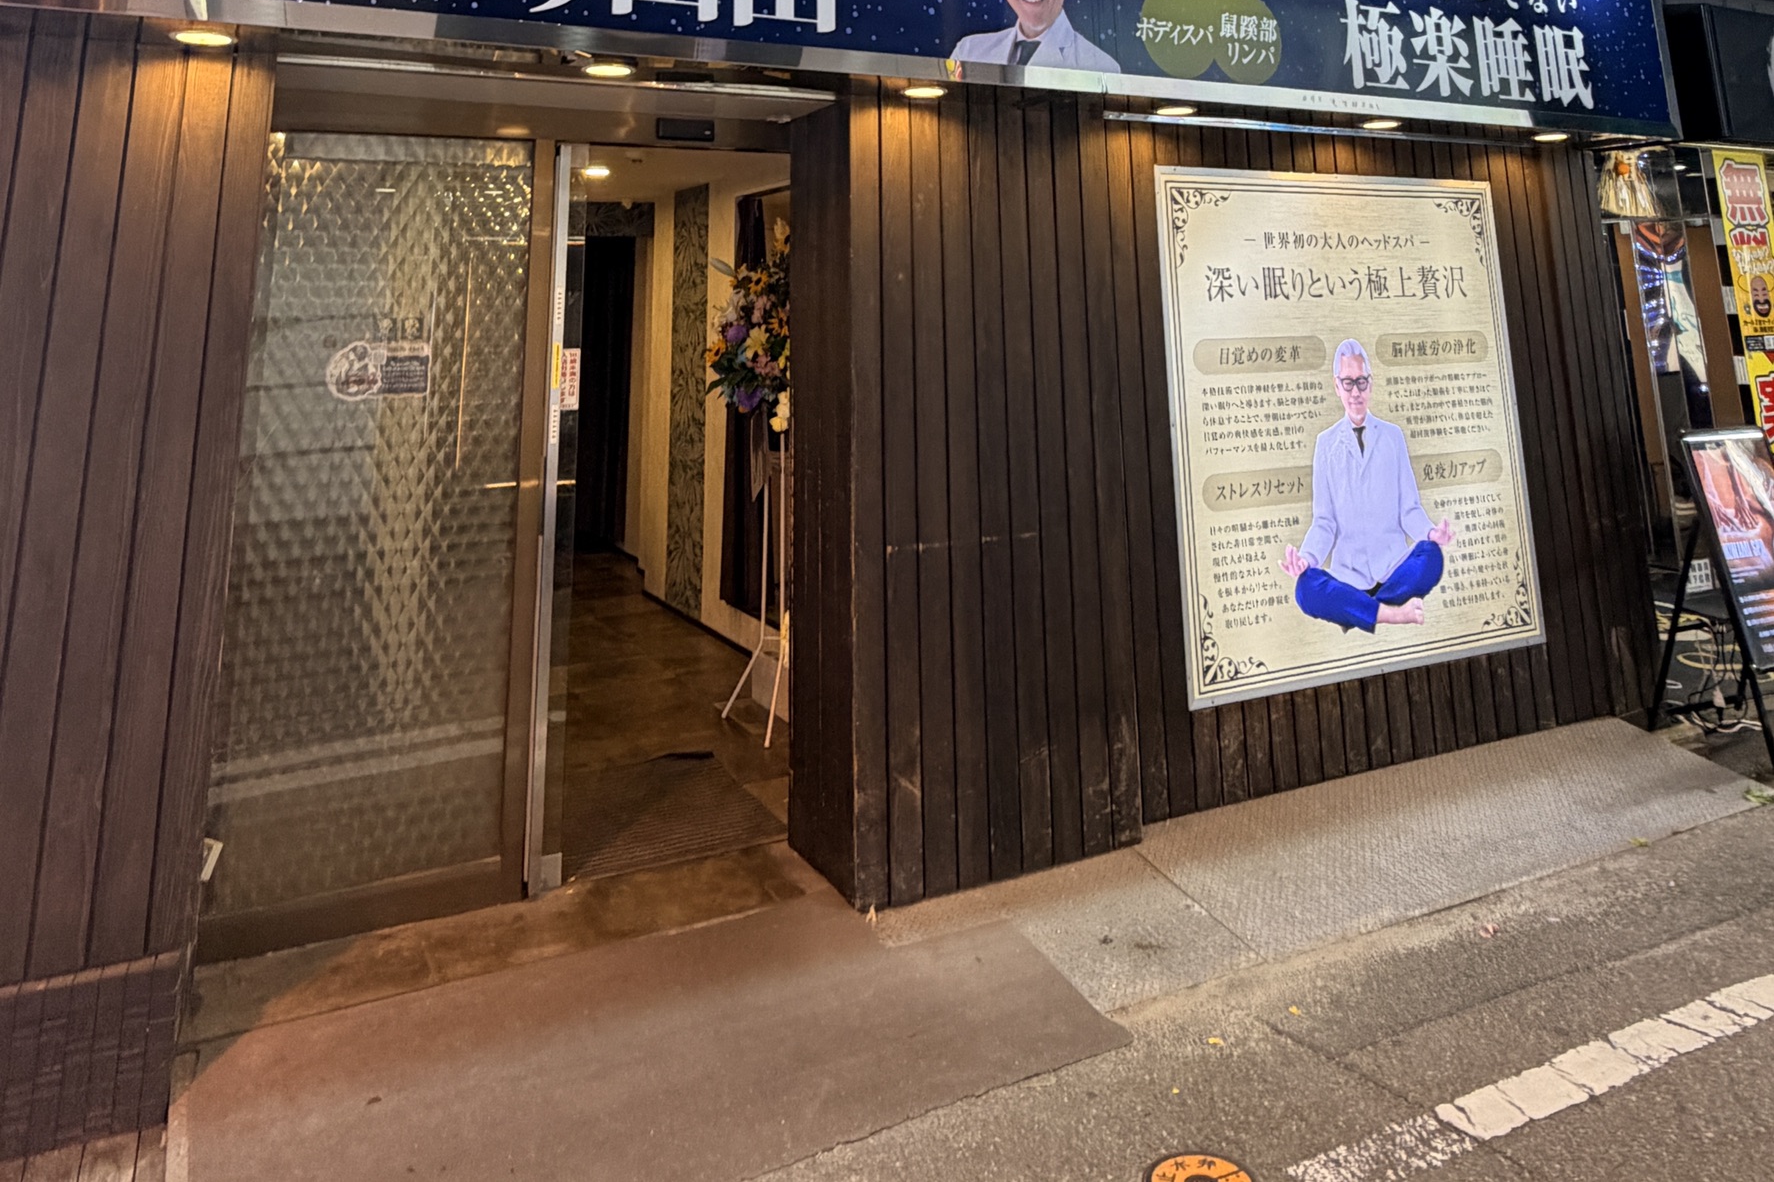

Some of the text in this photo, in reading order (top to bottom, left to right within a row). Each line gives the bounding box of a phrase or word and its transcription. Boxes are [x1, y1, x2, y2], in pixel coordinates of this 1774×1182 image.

[1135, 17, 1214, 45] ボディスパ
[1227, 42, 1275, 66] リンパ
[1205, 265, 1467, 302] 深い眠りという極上贅沢
[1219, 345, 1301, 366] 目覚めの変革
[1391, 339, 1477, 359] 脳内疲労の浄化
[1422, 459, 1487, 481] 免疫力アップ
[1215, 476, 1304, 501] ストレスリセット
